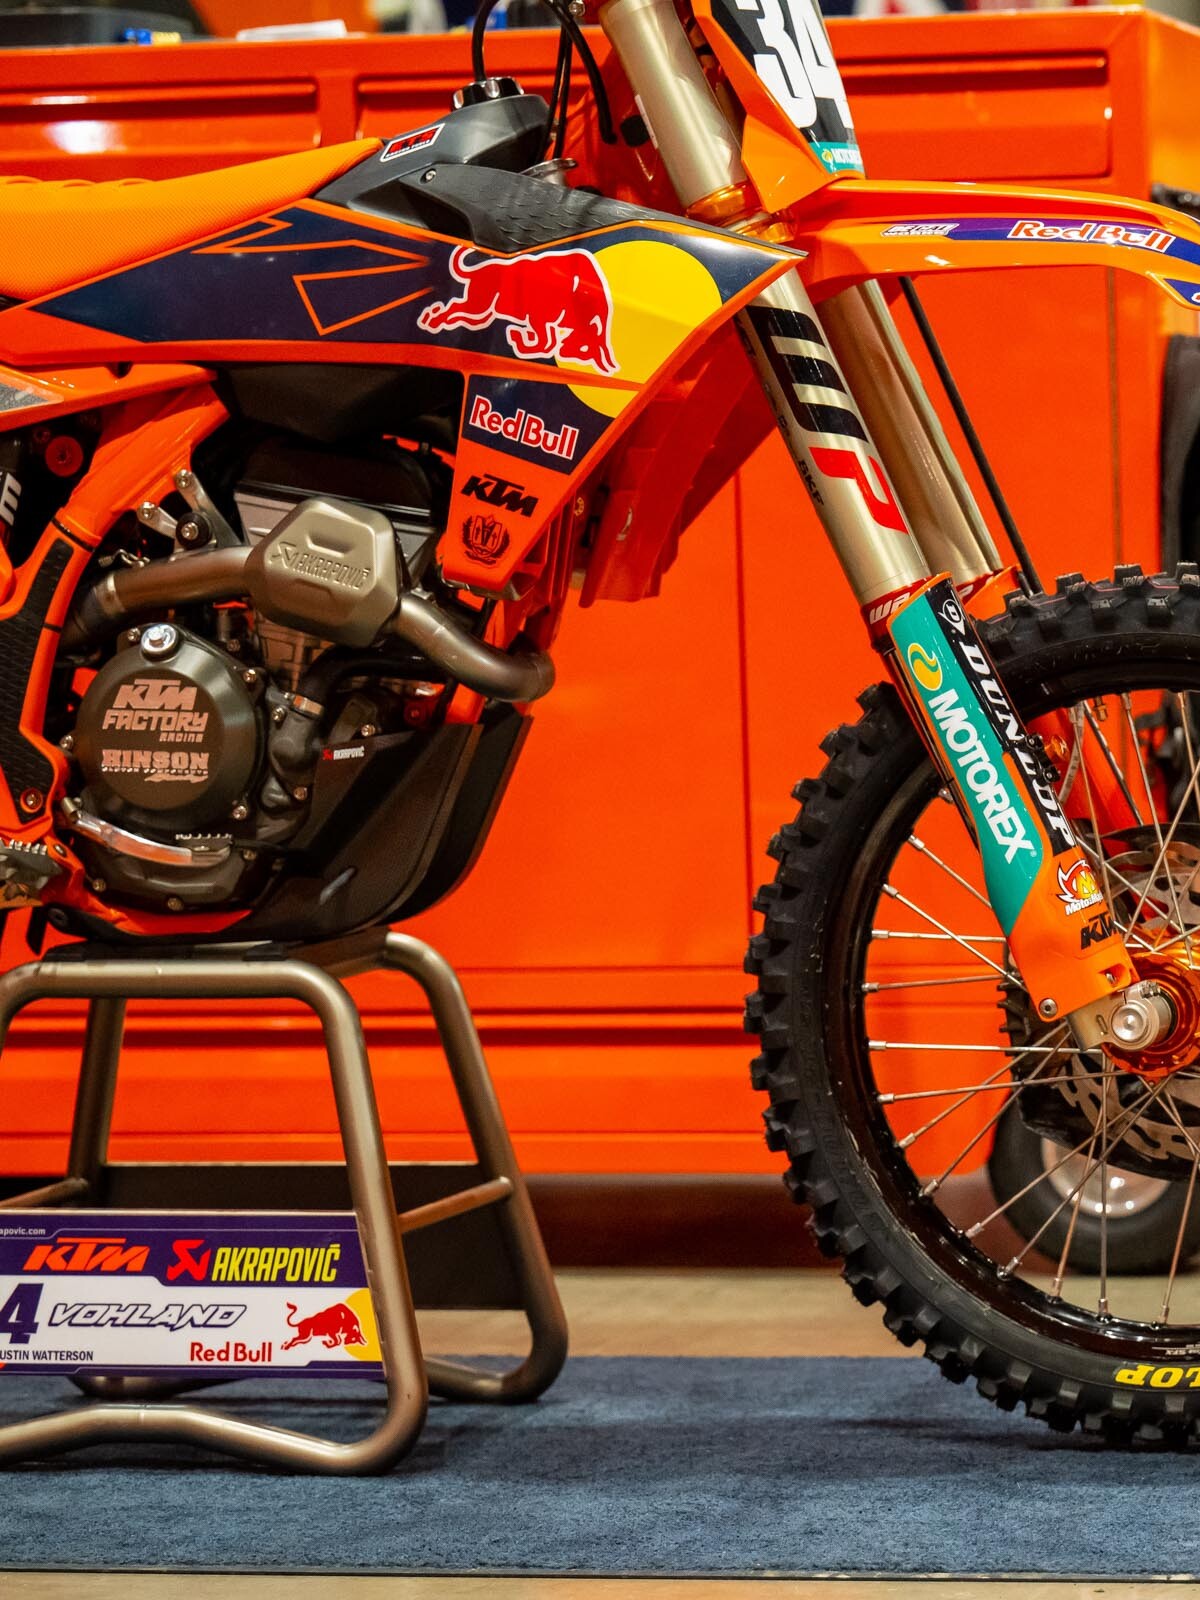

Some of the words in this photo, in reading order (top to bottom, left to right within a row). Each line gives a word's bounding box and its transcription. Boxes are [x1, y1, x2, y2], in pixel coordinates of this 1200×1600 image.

[736, 0, 855, 129] 34
[469, 394, 526, 441] Red
[520, 414, 580, 461] Bull
[461, 474, 539, 518] KTM
[112, 678, 197, 710] KTM
[102, 709, 209, 733] FACTORY
[159, 732, 204, 743] RACING
[101, 748, 209, 771] HINSON
[928, 688, 1036, 865] MOTOREX
[22, 1237, 150, 1272] KTM
[48, 1303, 247, 1332] VOHLAND
[32, 1350, 94, 1361] WATTERSON
[190, 1342, 230, 1362] Red
[233, 1343, 273, 1363] Bull
